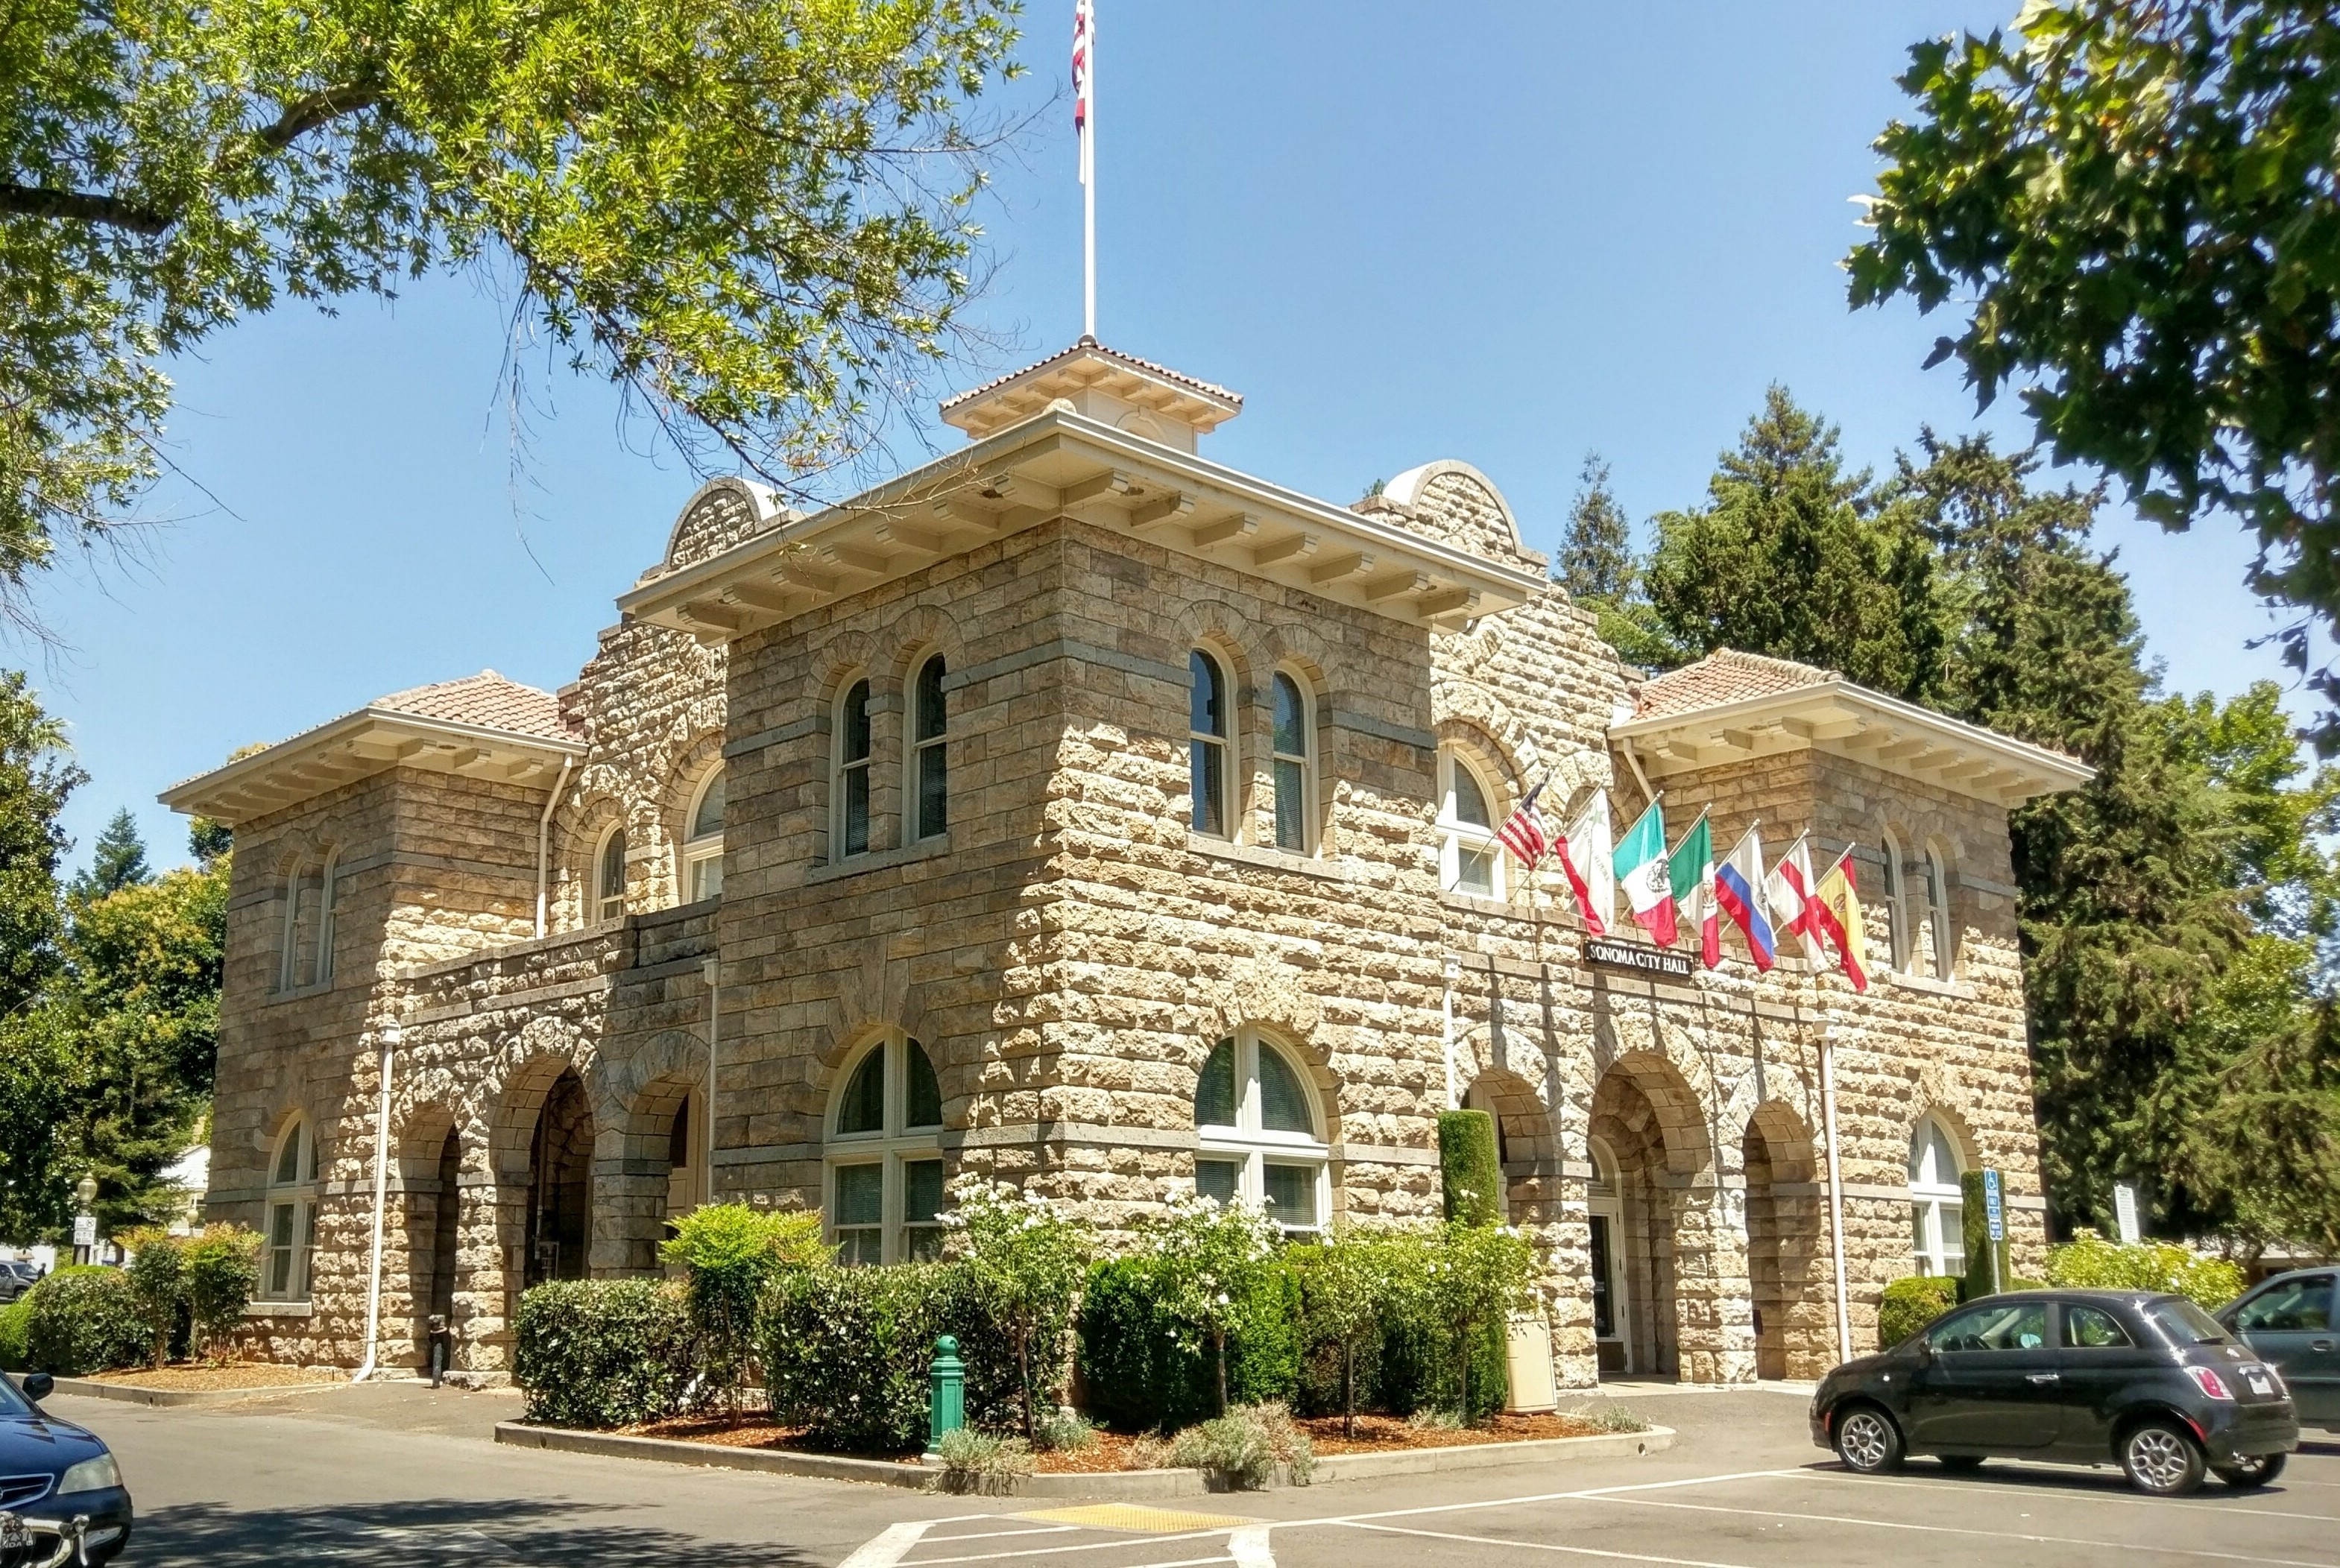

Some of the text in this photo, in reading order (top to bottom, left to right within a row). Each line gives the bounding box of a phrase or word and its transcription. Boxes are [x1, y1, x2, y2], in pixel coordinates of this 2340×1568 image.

[1590, 943, 1688, 974] SONOMA CITY HALL
